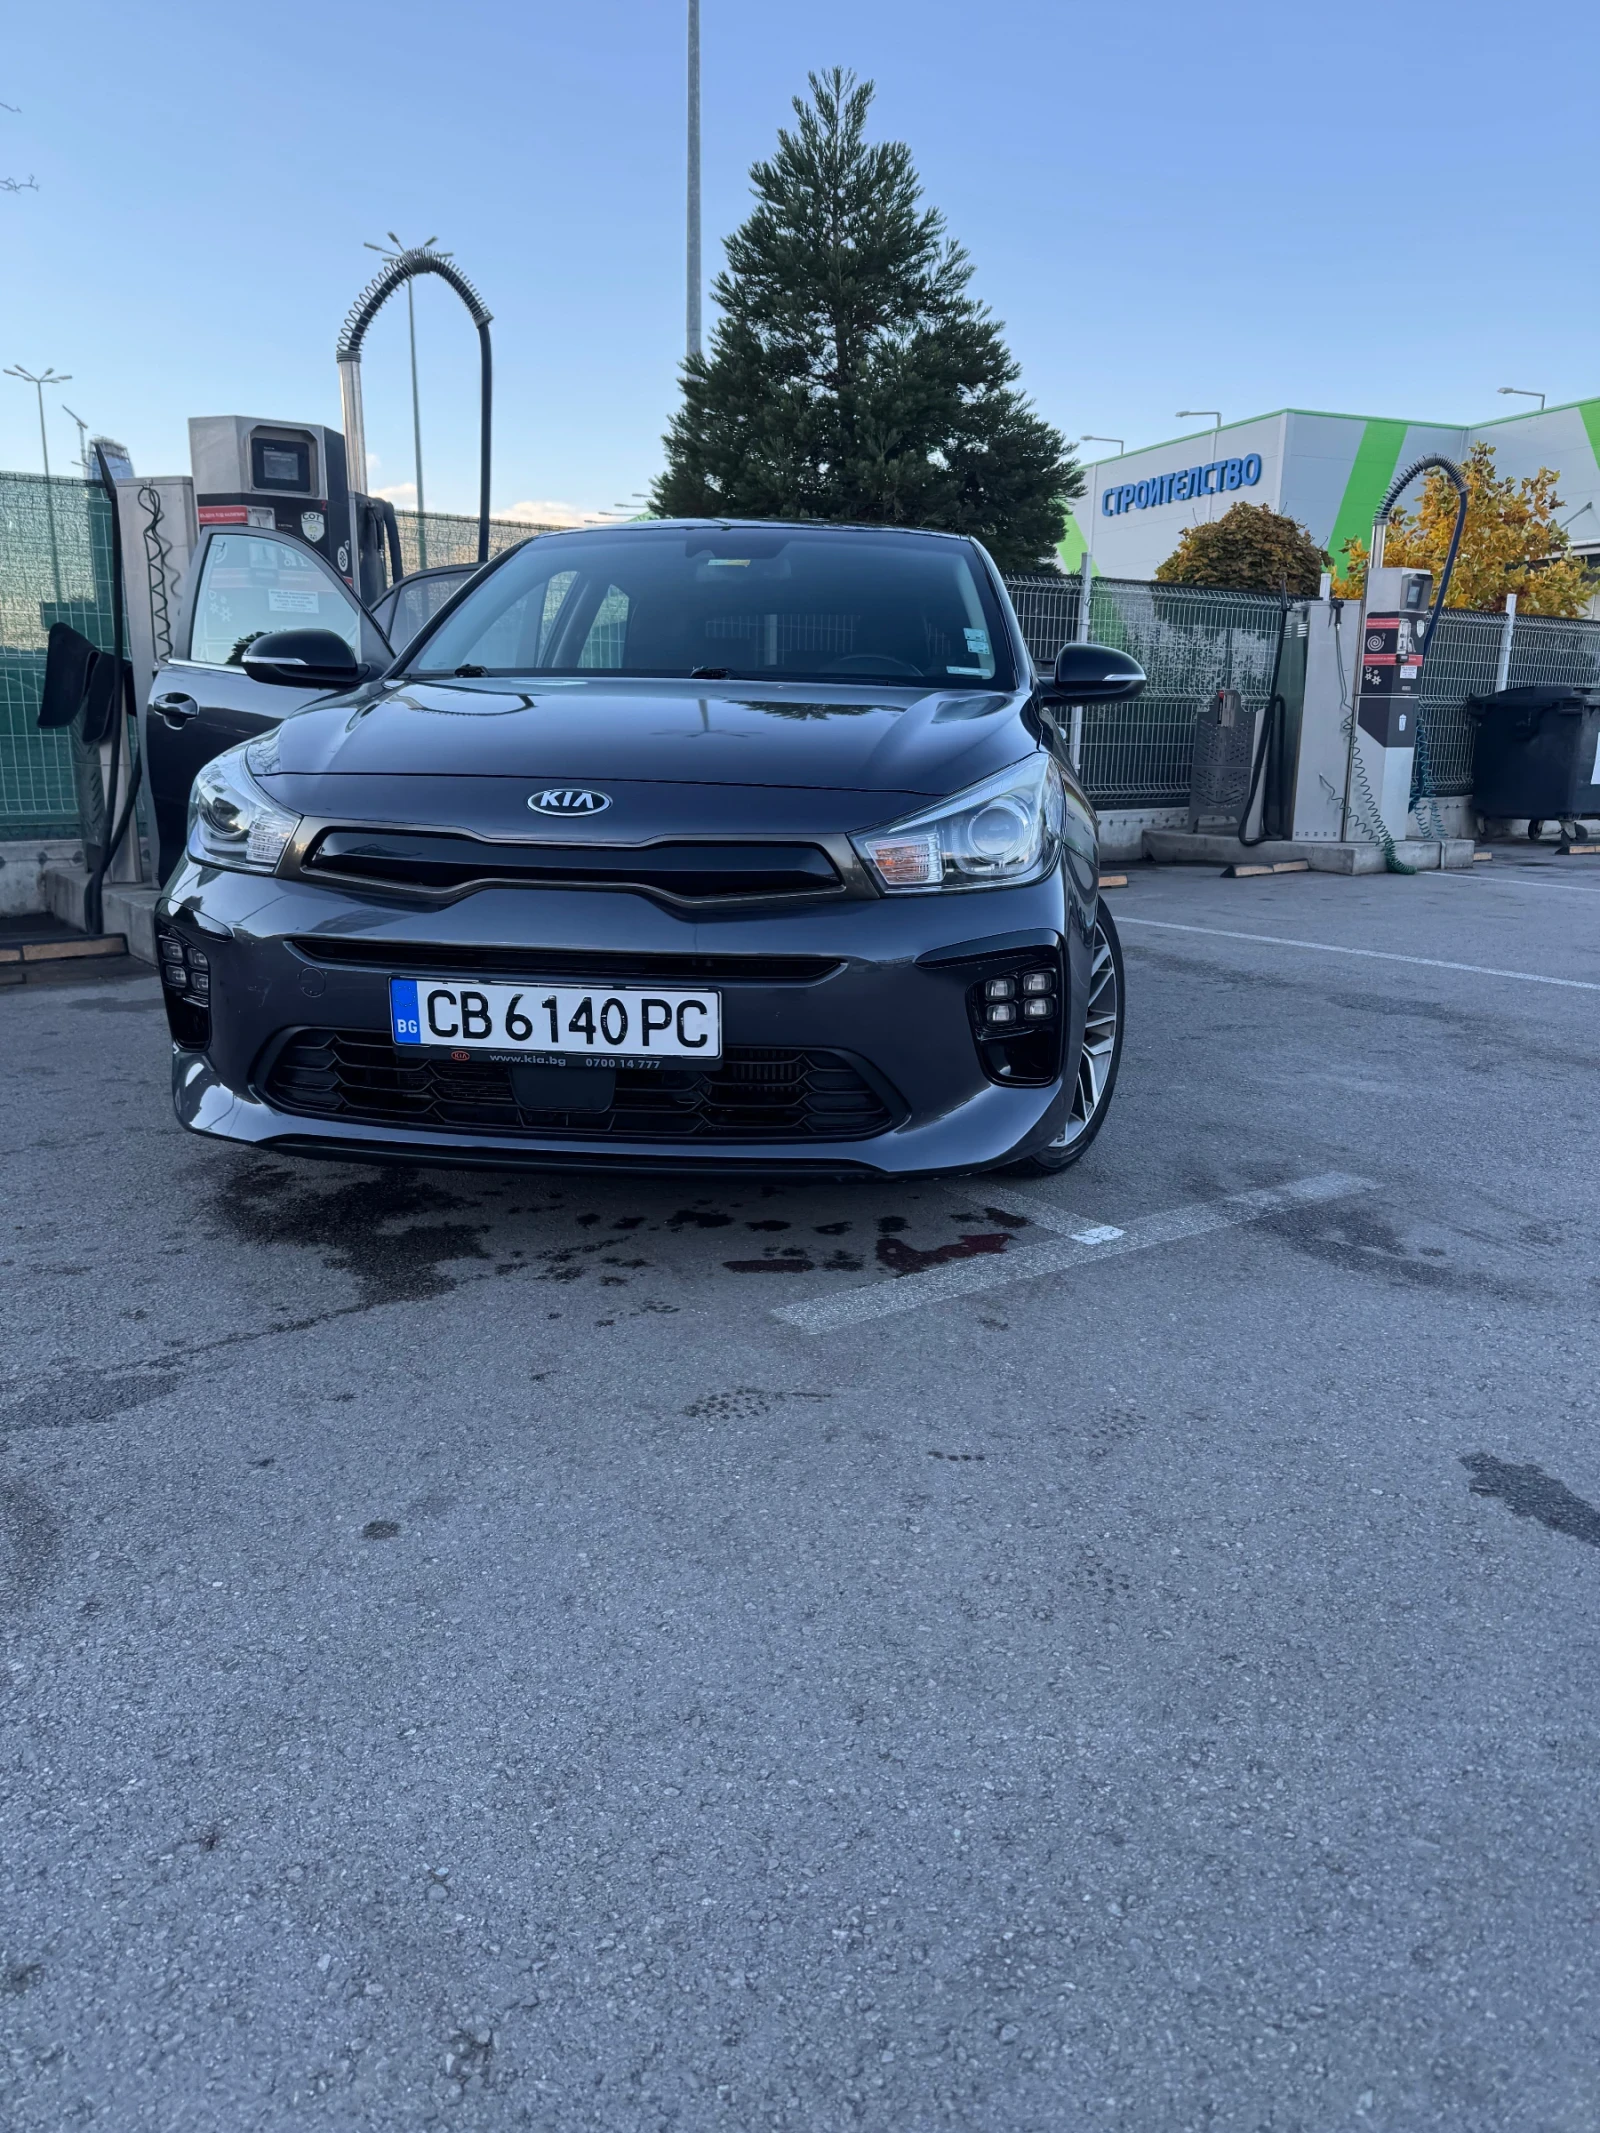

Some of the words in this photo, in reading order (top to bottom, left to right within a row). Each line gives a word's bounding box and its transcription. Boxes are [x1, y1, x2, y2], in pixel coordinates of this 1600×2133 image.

[1102, 453, 1262, 517] СТРОИТЕЛСТВО
[540, 791, 594, 809] KIA
[397, 1019, 418, 1034] BG
[427, 989, 493, 1040] CB
[505, 993, 629, 1046] 6140
[641, 998, 708, 1048] PC
[489, 1053, 566, 1067] www.kia.bg
[585, 1058, 616, 1068] 0700
[620, 1059, 635, 1069] 14
[637, 1060, 661, 1070] 777
